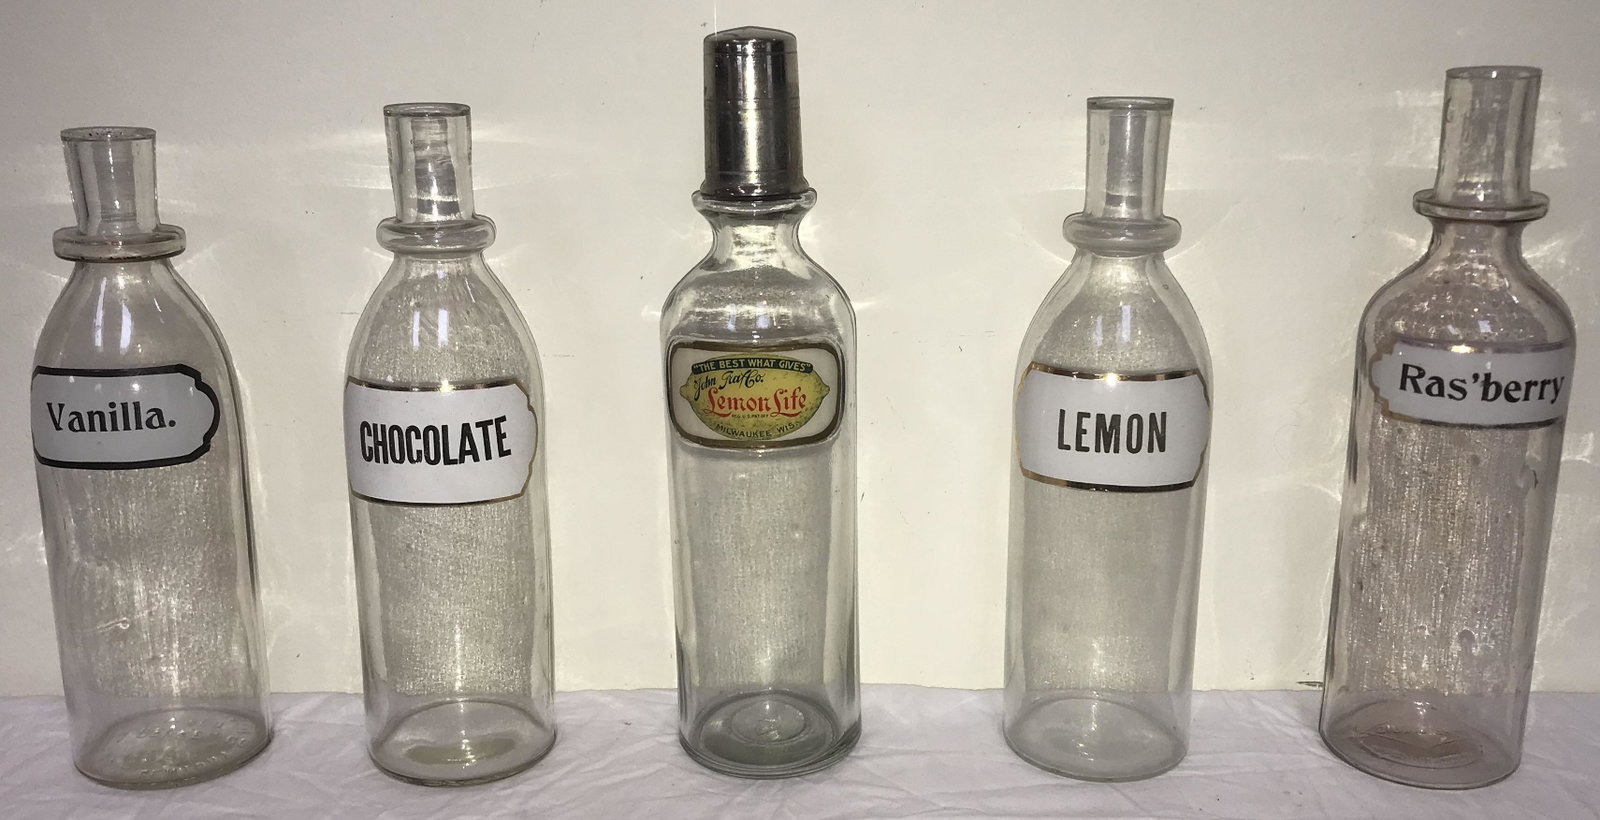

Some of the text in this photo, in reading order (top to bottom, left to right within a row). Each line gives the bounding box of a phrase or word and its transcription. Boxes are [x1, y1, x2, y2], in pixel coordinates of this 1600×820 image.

[693, 359, 811, 372] "THE BEST WHAT GIVES"
[693, 375, 717, 401] John
[718, 369, 751, 389] Graf
[1399, 363, 1565, 405] Ras'berry
[46, 401, 176, 433] Vanilla.
[703, 386, 807, 417] Lemon Life
[359, 414, 512, 466] CHOCOLATE
[716, 422, 799, 438] MILWAUKEE WIS.
[1057, 408, 1167, 454] LEMON
